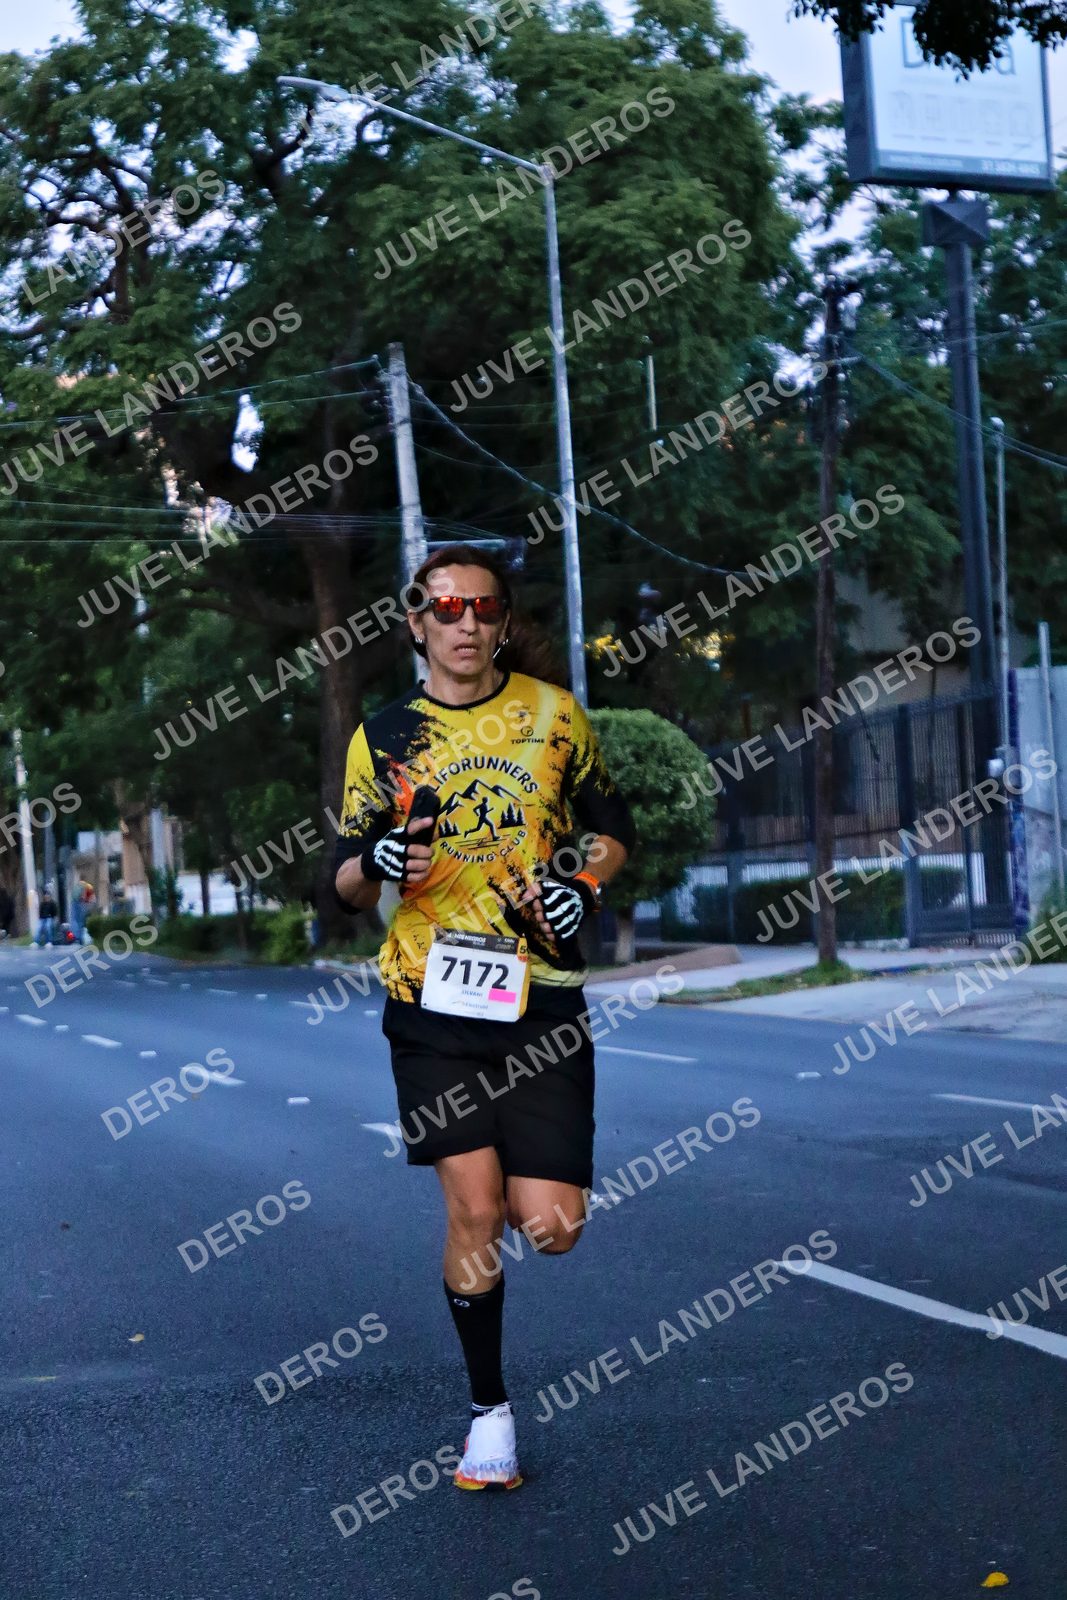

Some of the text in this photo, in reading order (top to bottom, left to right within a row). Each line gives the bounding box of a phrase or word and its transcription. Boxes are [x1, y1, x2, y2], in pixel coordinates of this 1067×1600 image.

[511, 737, 545, 745] TOPTIME
[440, 830, 526, 863] RUNNING CLUB
[441, 955, 509, 990] 7172
